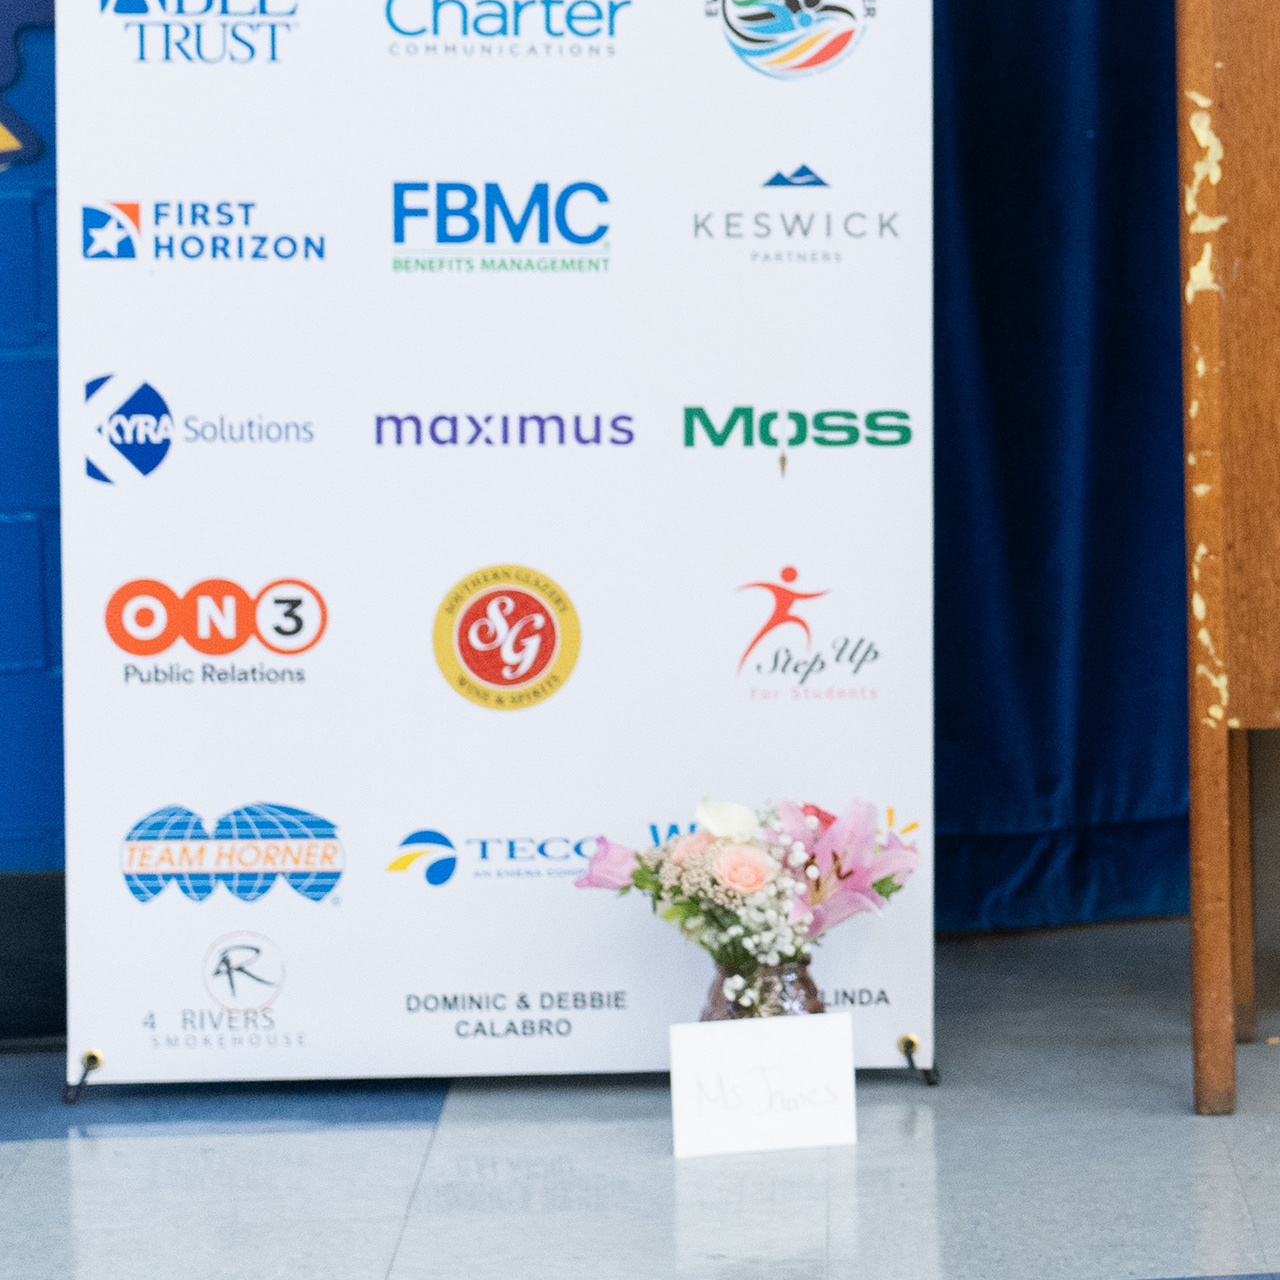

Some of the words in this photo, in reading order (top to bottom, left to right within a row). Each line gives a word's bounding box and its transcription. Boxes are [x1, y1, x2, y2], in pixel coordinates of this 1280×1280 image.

[124, 21, 291, 64] TRUST
[389, 42, 617, 57] COMMUNICATIONS
[154, 202, 256, 227] FIRST
[393, 181, 611, 245] FBMC
[693, 211, 900, 239] KESWICK
[154, 235, 326, 261] HORIZON
[751, 251, 843, 264] PARTNERS
[393, 257, 475, 273] BENEFITS
[481, 257, 611, 274] MANAGEMENT
[107, 412, 175, 446] KYRA
[184, 415, 315, 445] Solutions
[375, 413, 635, 446] maximus
[756, 647, 826, 686] Step
[831, 636, 880, 674] Up
[124, 664, 194, 685] Public
[201, 664, 306, 685] Relations
[125, 844, 205, 868] TEAM
[215, 843, 339, 868] HORNER
[407, 993, 507, 1012] DOMINIC
[516, 993, 531, 1010] &
[539, 991, 629, 1010] DEBBIE
[142, 1010, 157, 1031] 4
[181, 1008, 276, 1031] RIVERS
[456, 1018, 573, 1038] CALABRO
[149, 1032, 308, 1049] SMOKEHOUSE
